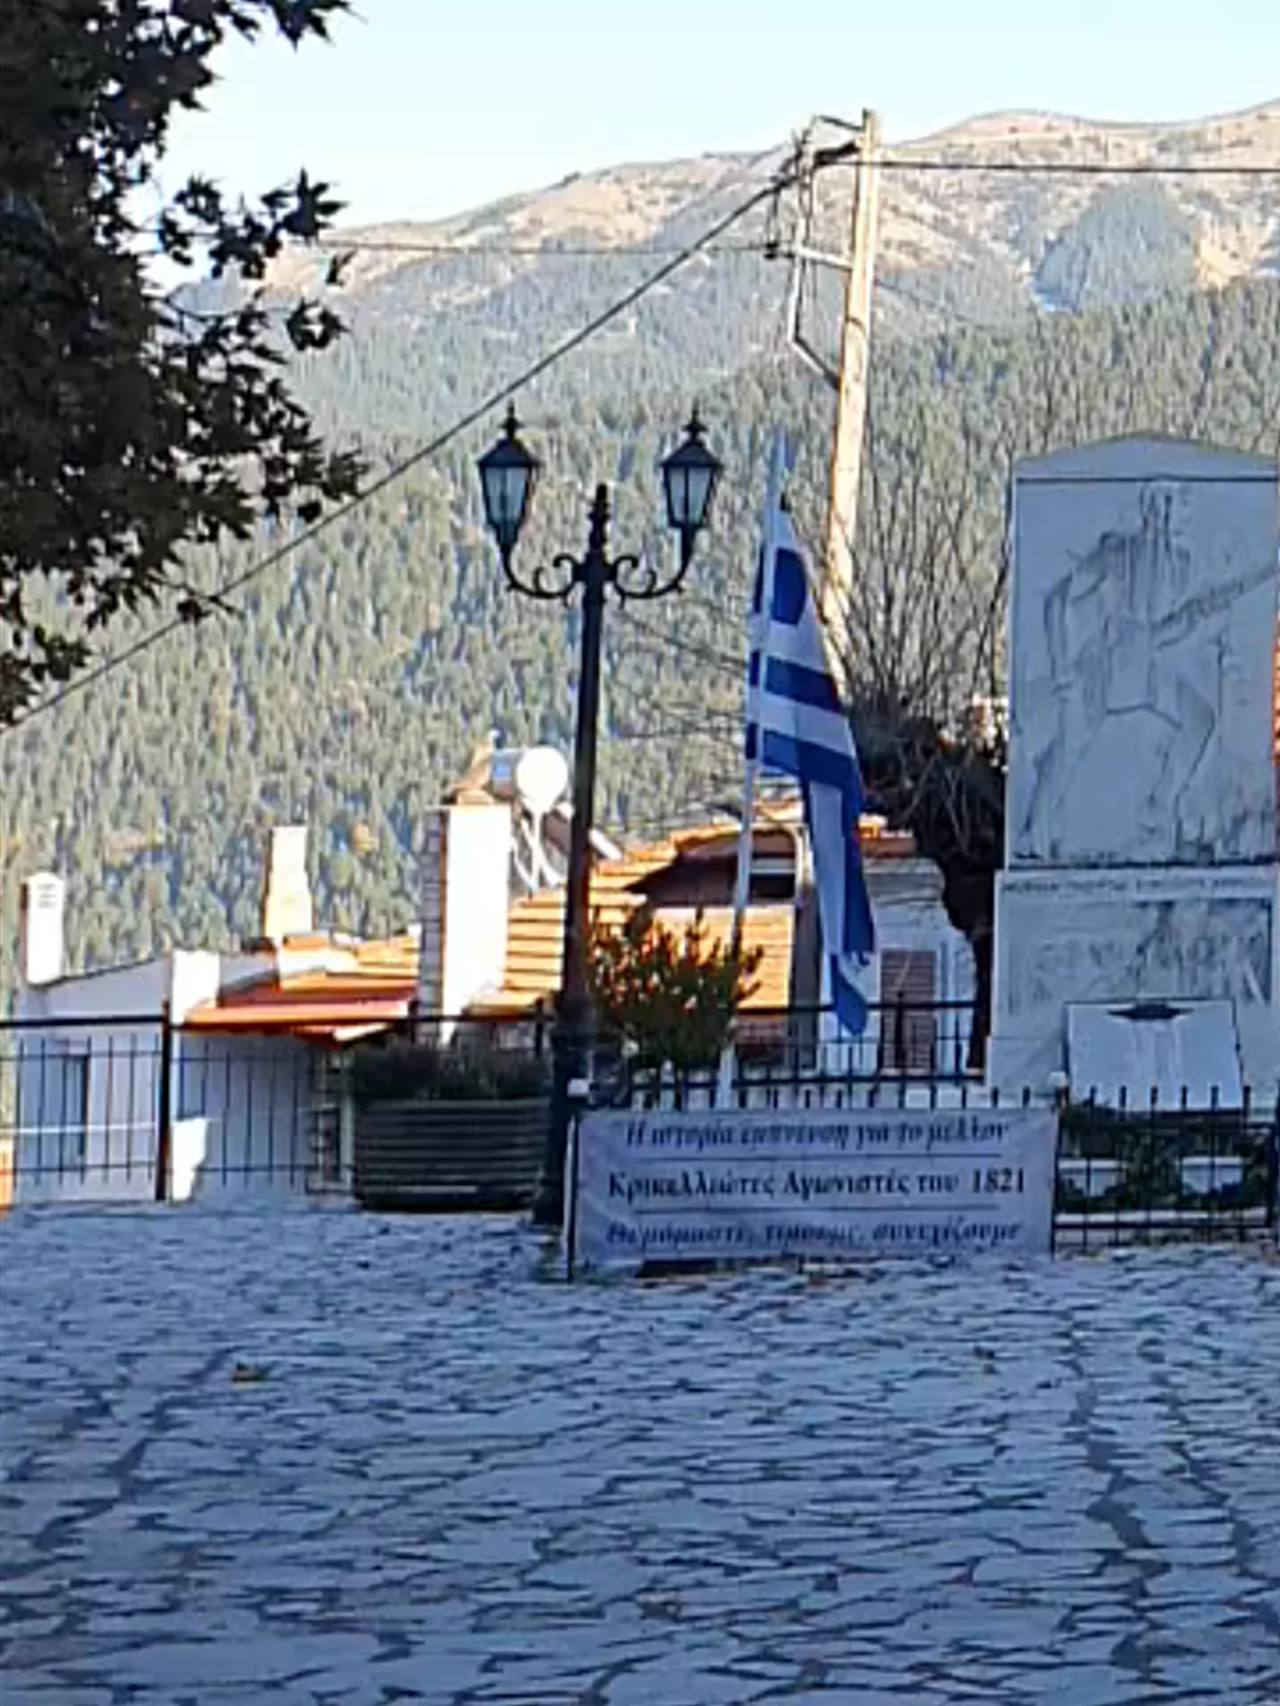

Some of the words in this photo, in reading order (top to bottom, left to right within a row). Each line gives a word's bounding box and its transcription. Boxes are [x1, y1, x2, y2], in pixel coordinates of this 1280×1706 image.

[855, 1123, 891, 1150] για
[782, 1168, 911, 1202] Αγωνιστές
[916, 1175, 960, 1195] του
[971, 1167, 1025, 1195] 1821
